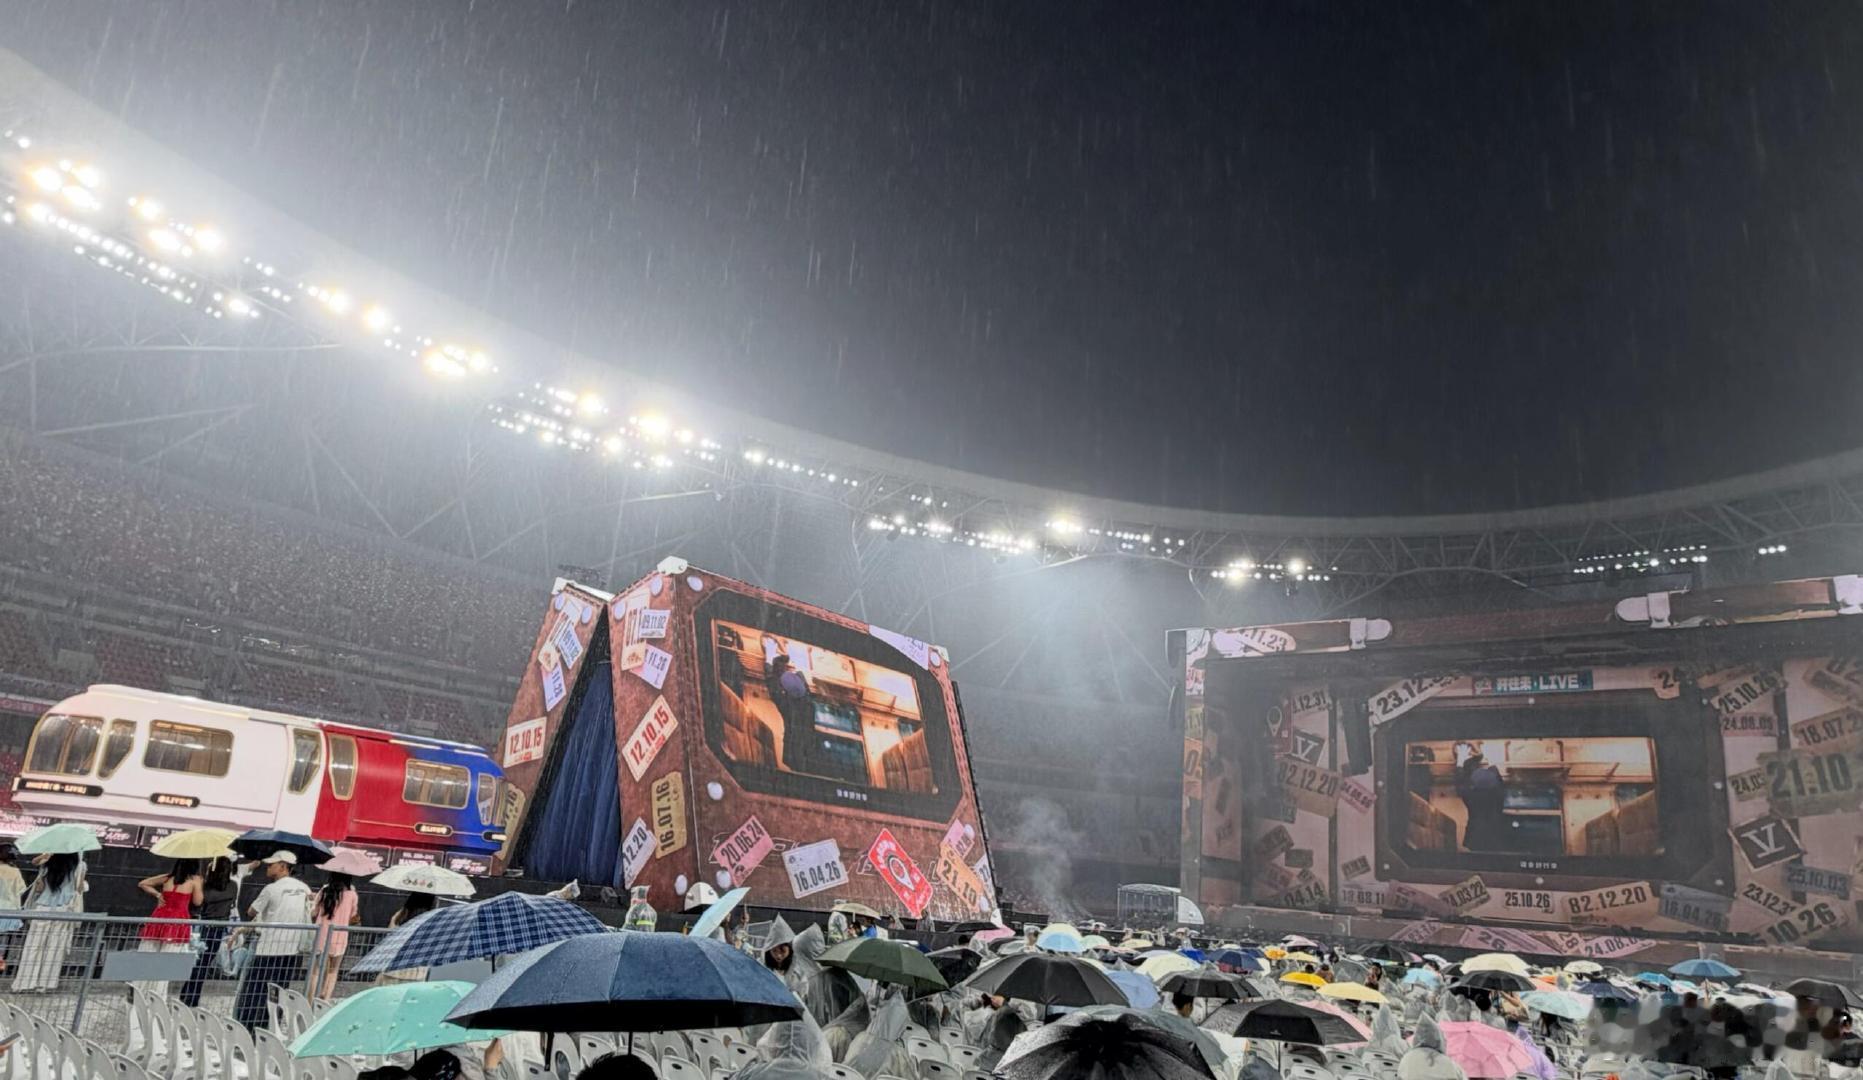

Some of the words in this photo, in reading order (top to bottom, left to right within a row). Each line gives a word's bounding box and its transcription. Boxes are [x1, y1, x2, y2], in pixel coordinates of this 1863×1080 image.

[509, 727, 542, 755] 12.10.15
[630, 705, 670, 767] 12.10.15
[655, 780, 676, 852] 16.07.16
[720, 820, 765, 869] 20.06.24
[1741, 823, 1786, 859] V
[793, 860, 842, 893] 16.04.26
[1504, 892, 1551, 909] 25.10.26
[1568, 886, 1647, 915] 82.12.20
